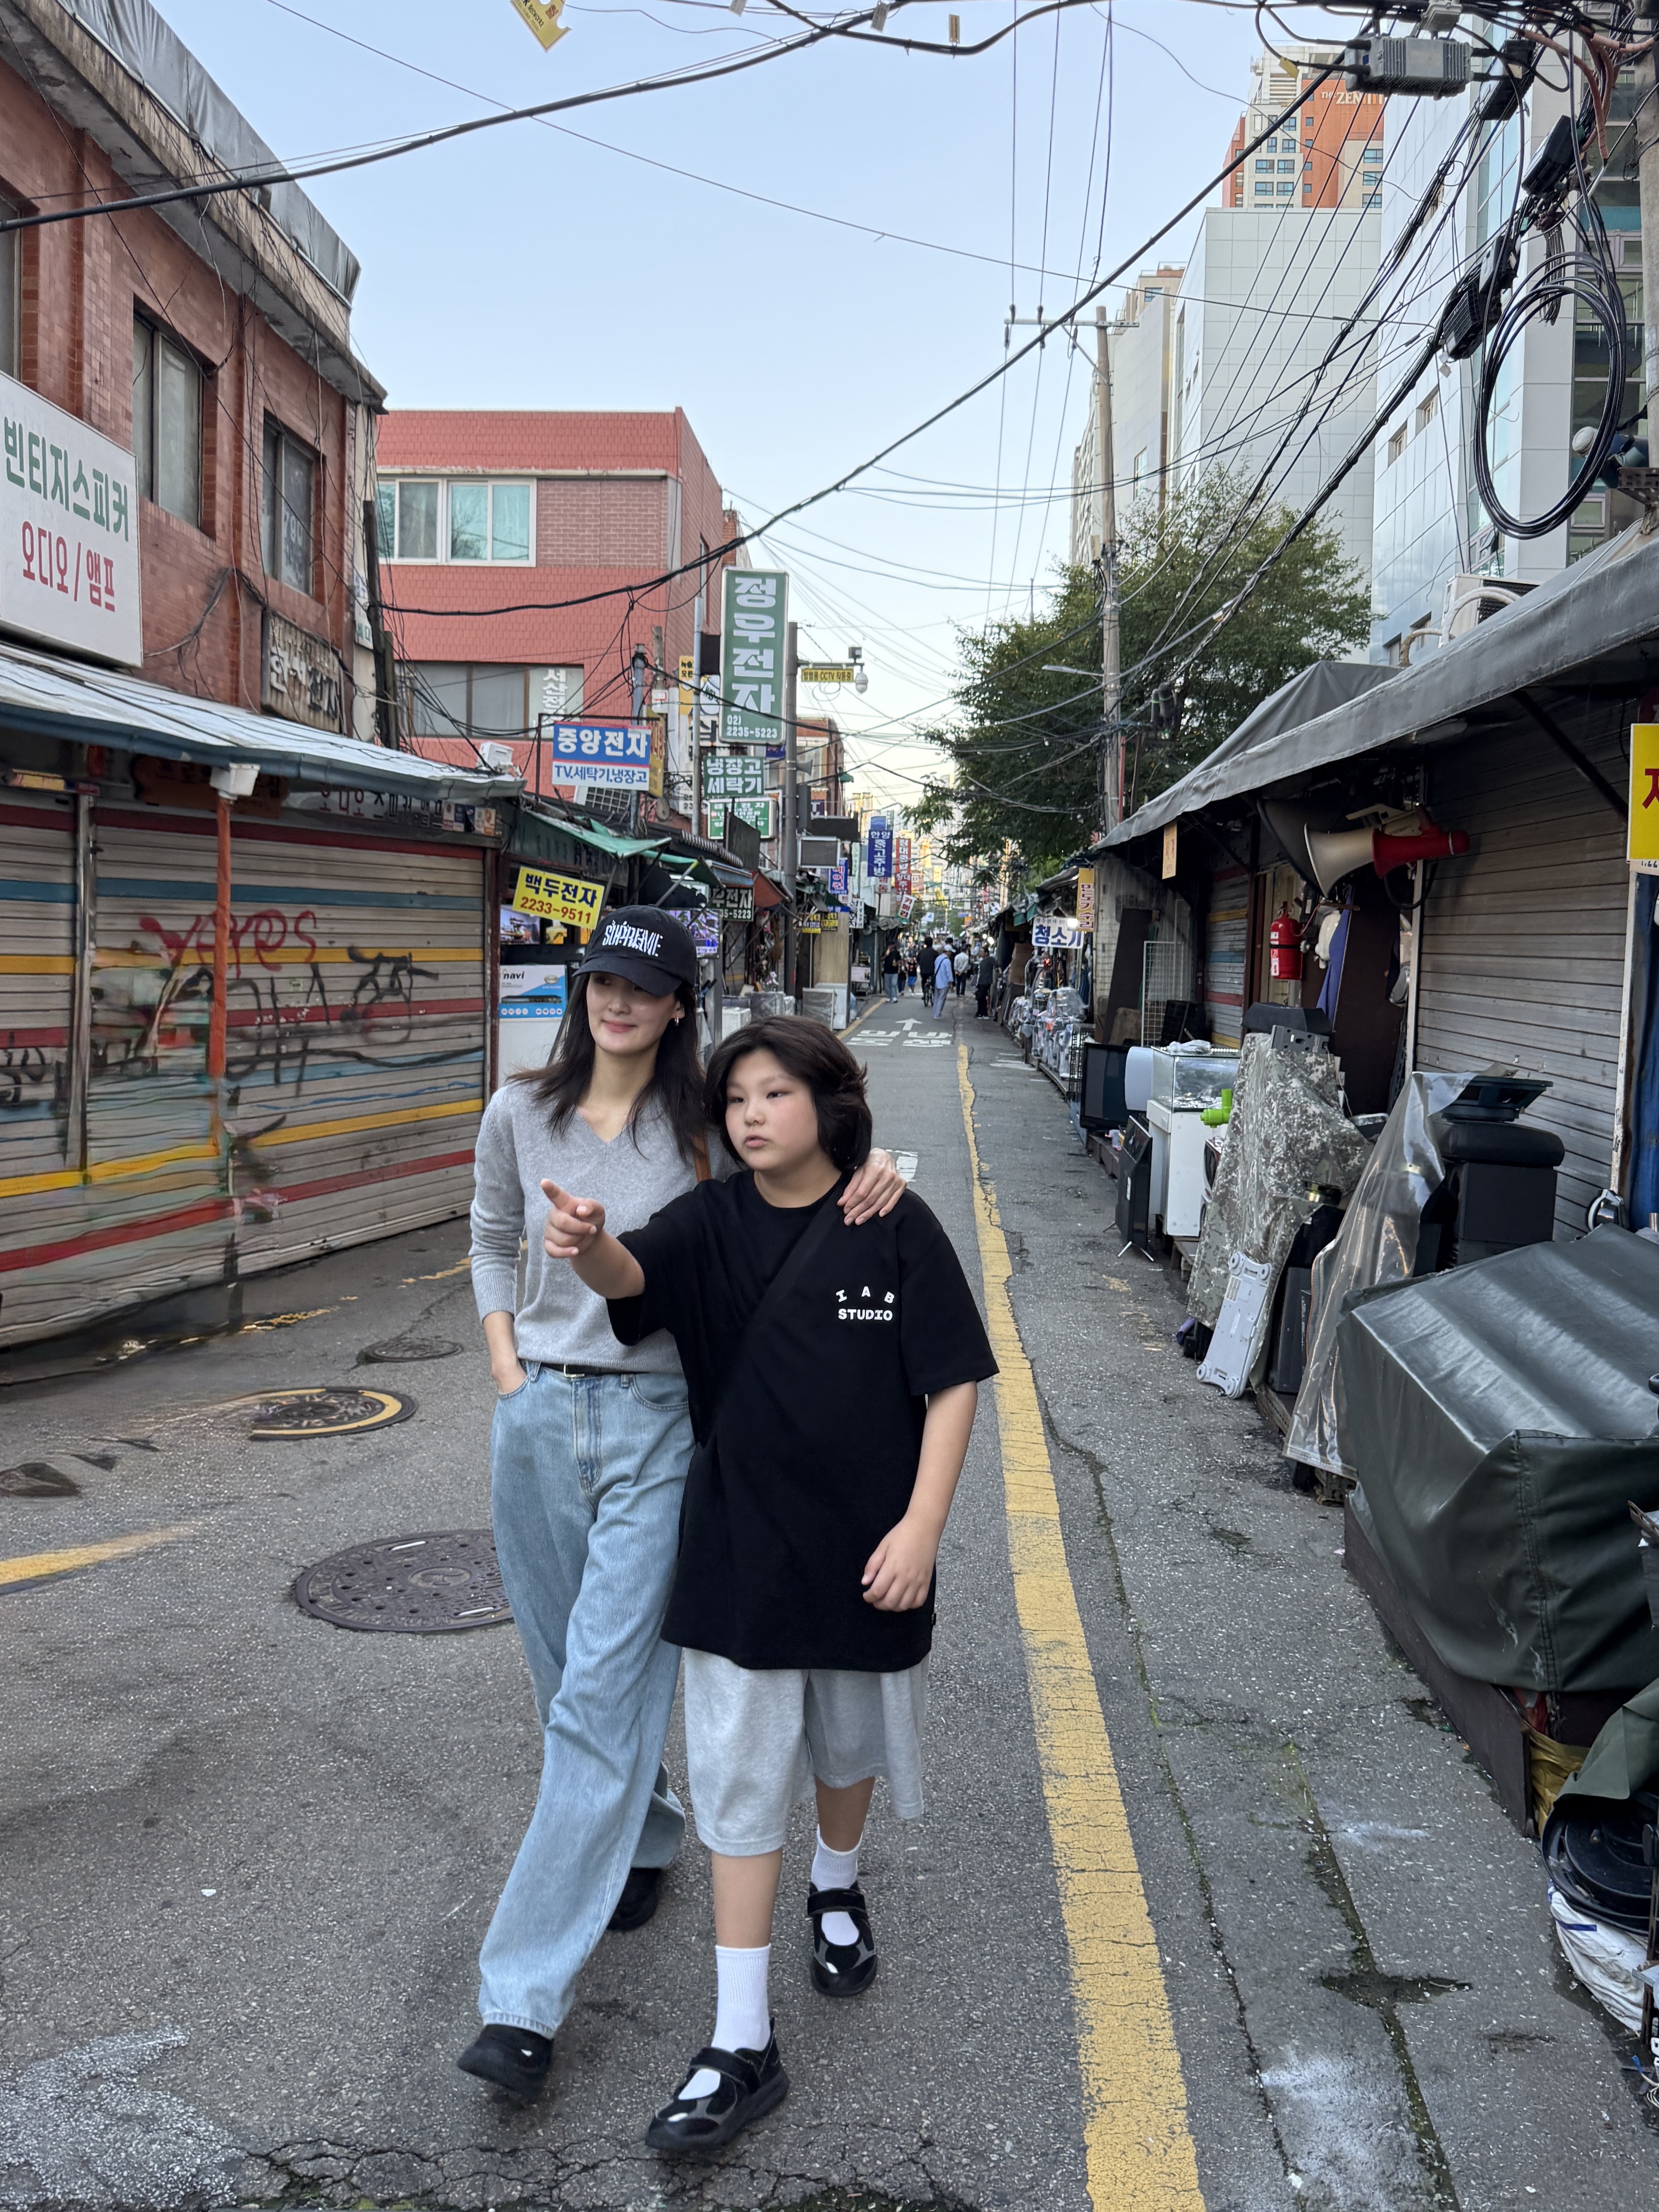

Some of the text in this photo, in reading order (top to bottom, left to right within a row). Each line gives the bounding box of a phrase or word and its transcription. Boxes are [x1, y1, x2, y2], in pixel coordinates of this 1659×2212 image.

[4, 416, 128, 542] 빈티지스피커
[731, 577, 777, 713] 정우전자
[820, 671, 835, 681] CCTV
[726, 715, 741, 726] 02)
[557, 728, 648, 758] 중앙전자
[726, 726, 778, 739] 2235-5223
[706, 758, 762, 775] 냉장고
[873, 839, 886, 876] 중고주방
[525, 873, 597, 908] 백두전자
[710, 888, 752, 909] 우전자
[520, 896, 591, 924] 2233-9511
[1035, 924, 1082, 947] 청소기
[838, 1308, 893, 1321] STUDIO
